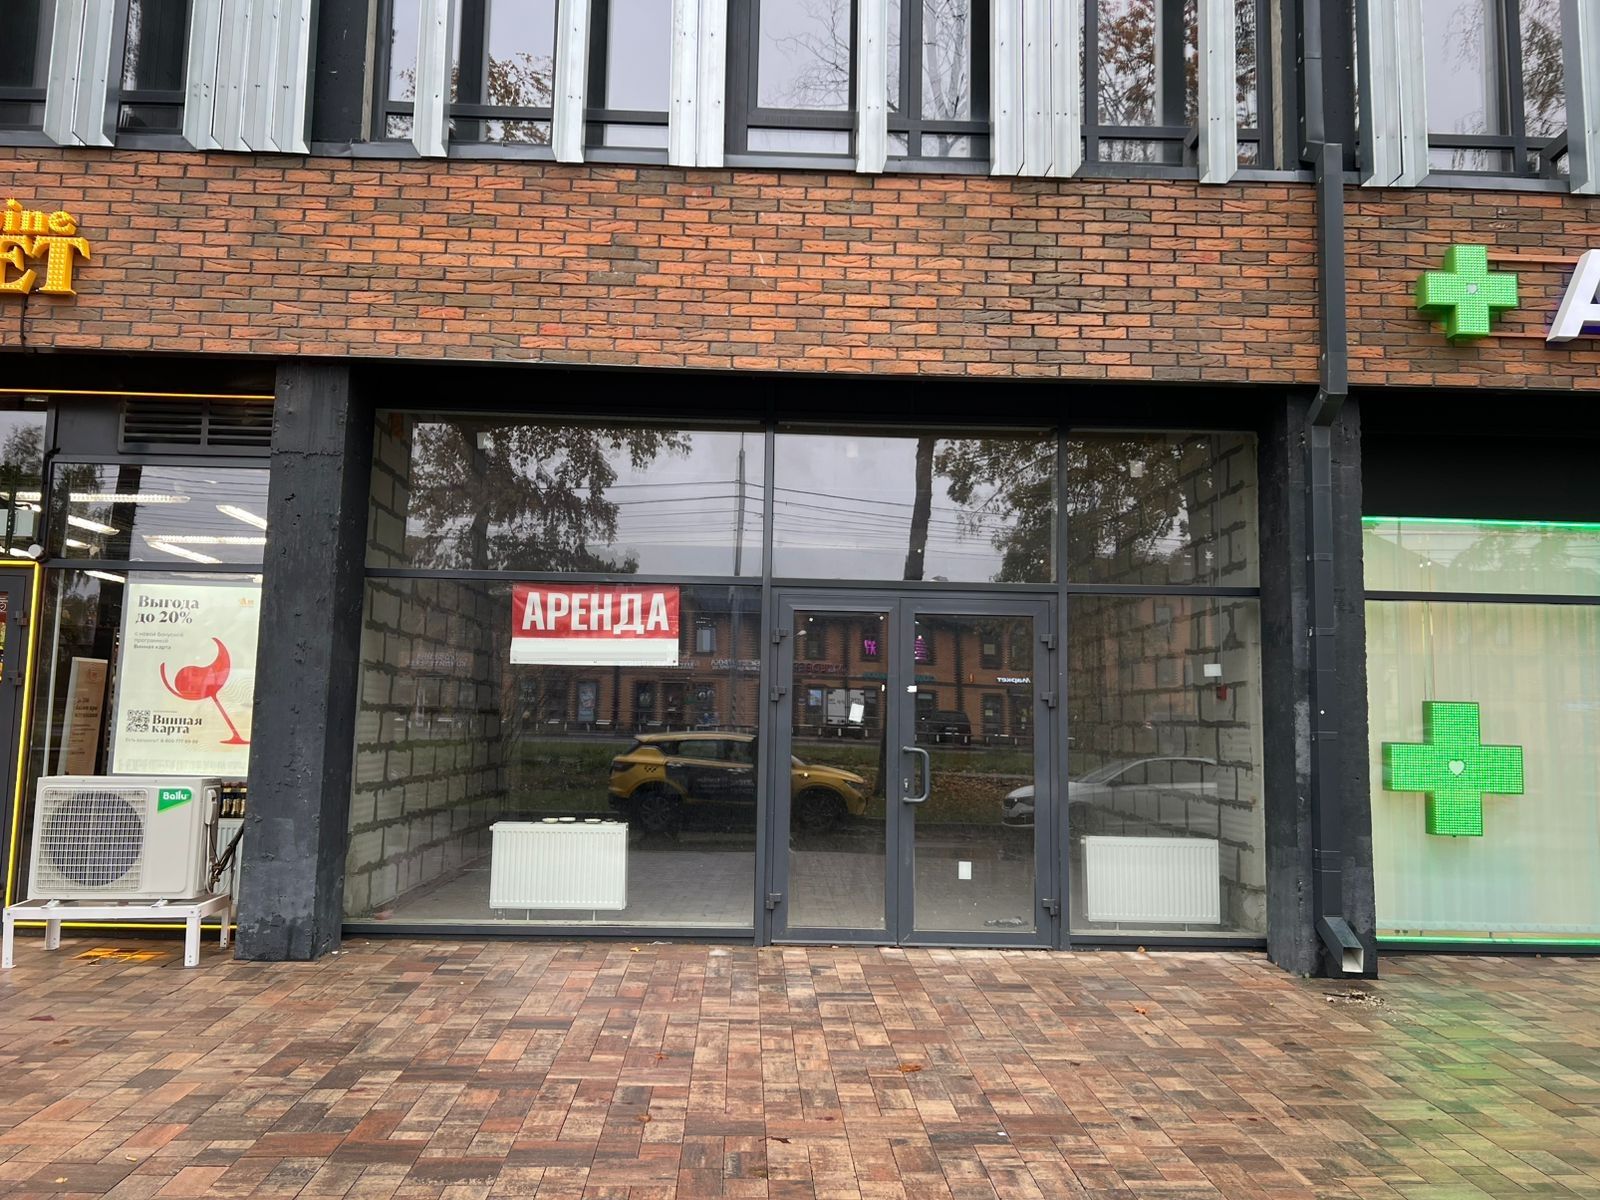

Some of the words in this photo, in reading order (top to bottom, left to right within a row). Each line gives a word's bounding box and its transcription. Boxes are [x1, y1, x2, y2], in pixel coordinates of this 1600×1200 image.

[0, 198, 77, 235] ine
[138, 594, 200, 610] Выгода
[135, 612, 156, 624] до
[159, 610, 193, 624] 20%
[521, 591, 670, 635] АРЕНДА
[152, 714, 203, 726] Винная
[151, 725, 190, 735] карта
[162, 790, 188, 800] Ballu
